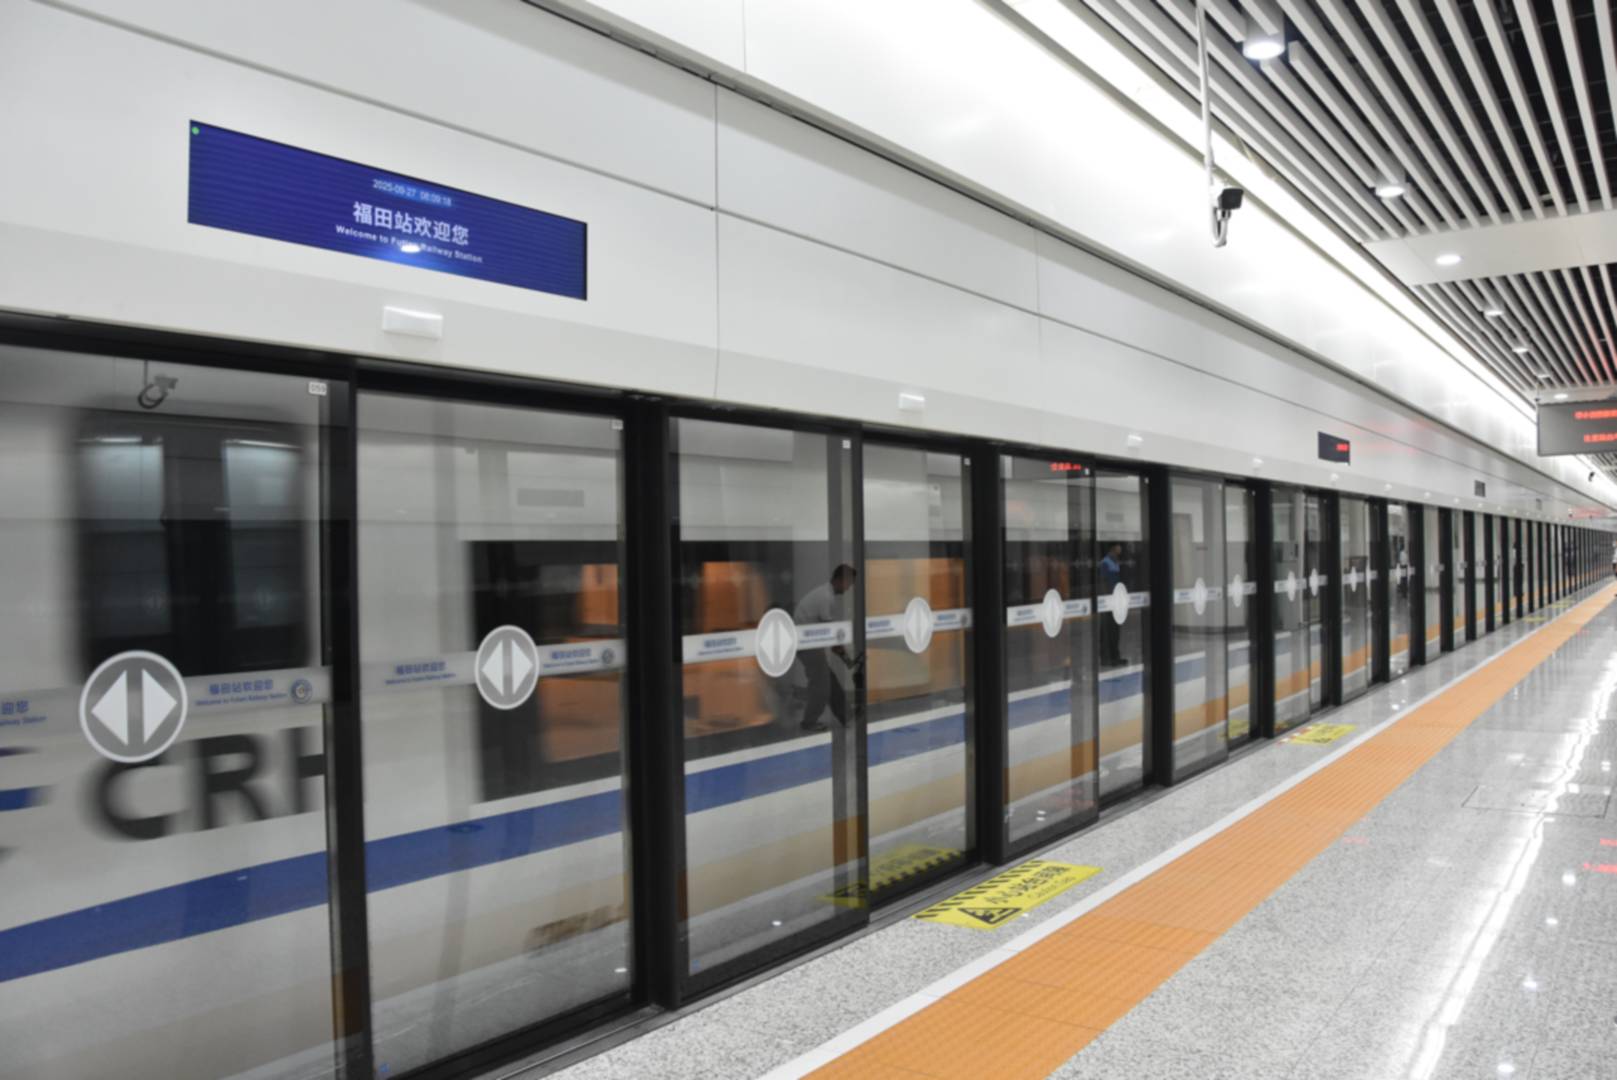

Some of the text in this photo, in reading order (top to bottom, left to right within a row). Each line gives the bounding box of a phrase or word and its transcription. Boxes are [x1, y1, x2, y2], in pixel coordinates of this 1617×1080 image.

[335, 224, 377, 241] Welcome
[379, 234, 389, 244] to
[454, 249, 483, 263] Station
[352, 201, 469, 246] 福田站欢迎您
